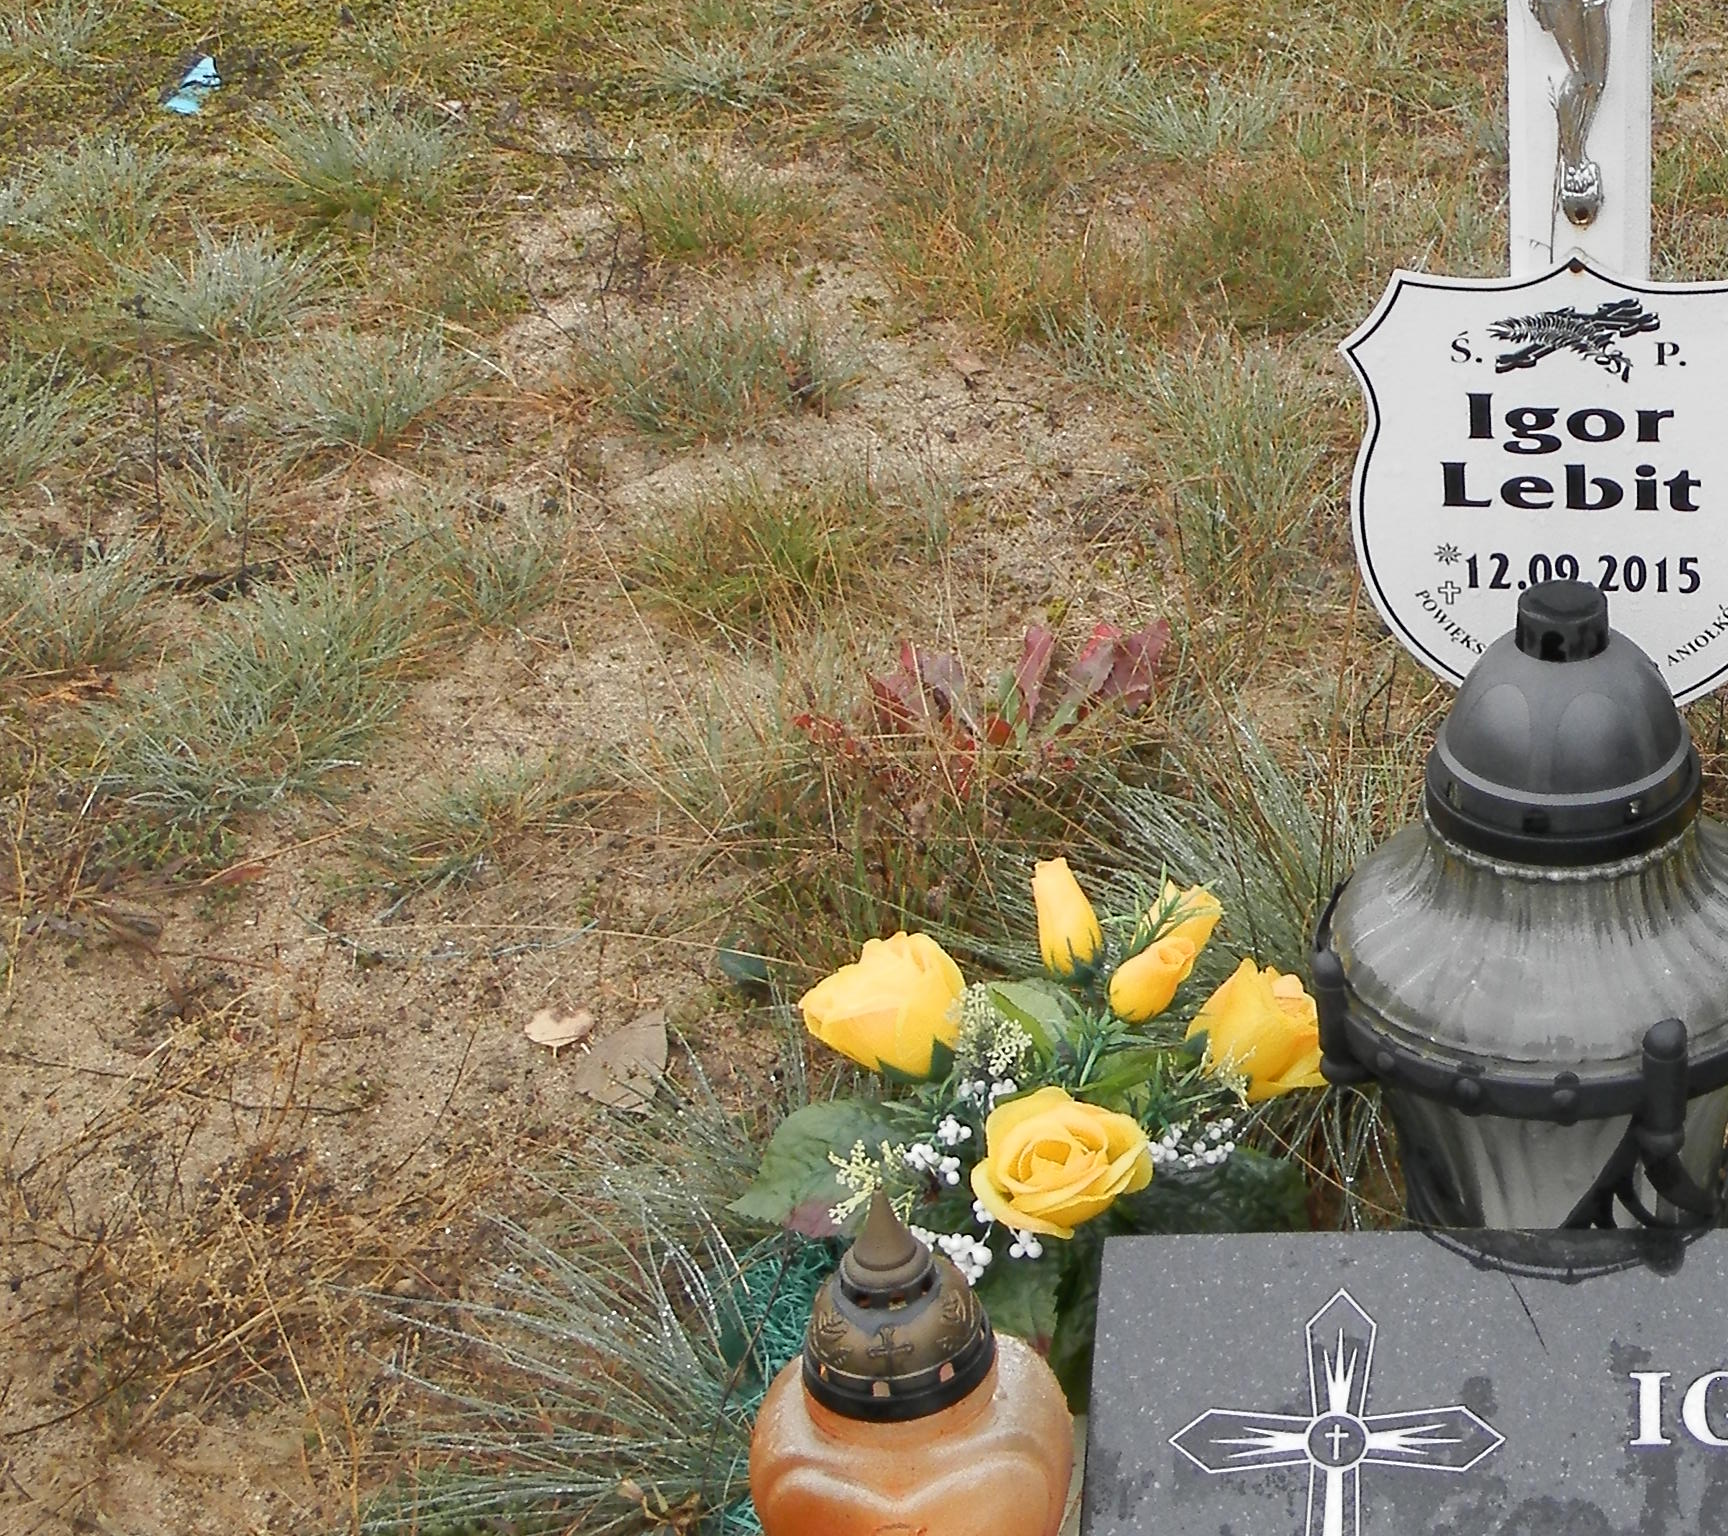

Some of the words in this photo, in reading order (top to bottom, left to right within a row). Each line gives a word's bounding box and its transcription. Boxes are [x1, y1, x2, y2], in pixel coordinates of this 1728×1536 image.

[1449, 330, 1483, 364] Ś.
[1654, 340, 1687, 367] P.
[1465, 392, 1675, 455] Igor
[1439, 461, 1702, 513] Lebit
[1465, 552, 1701, 594] 12.092015
[1415, 590, 1486, 655] POWIĘKS
